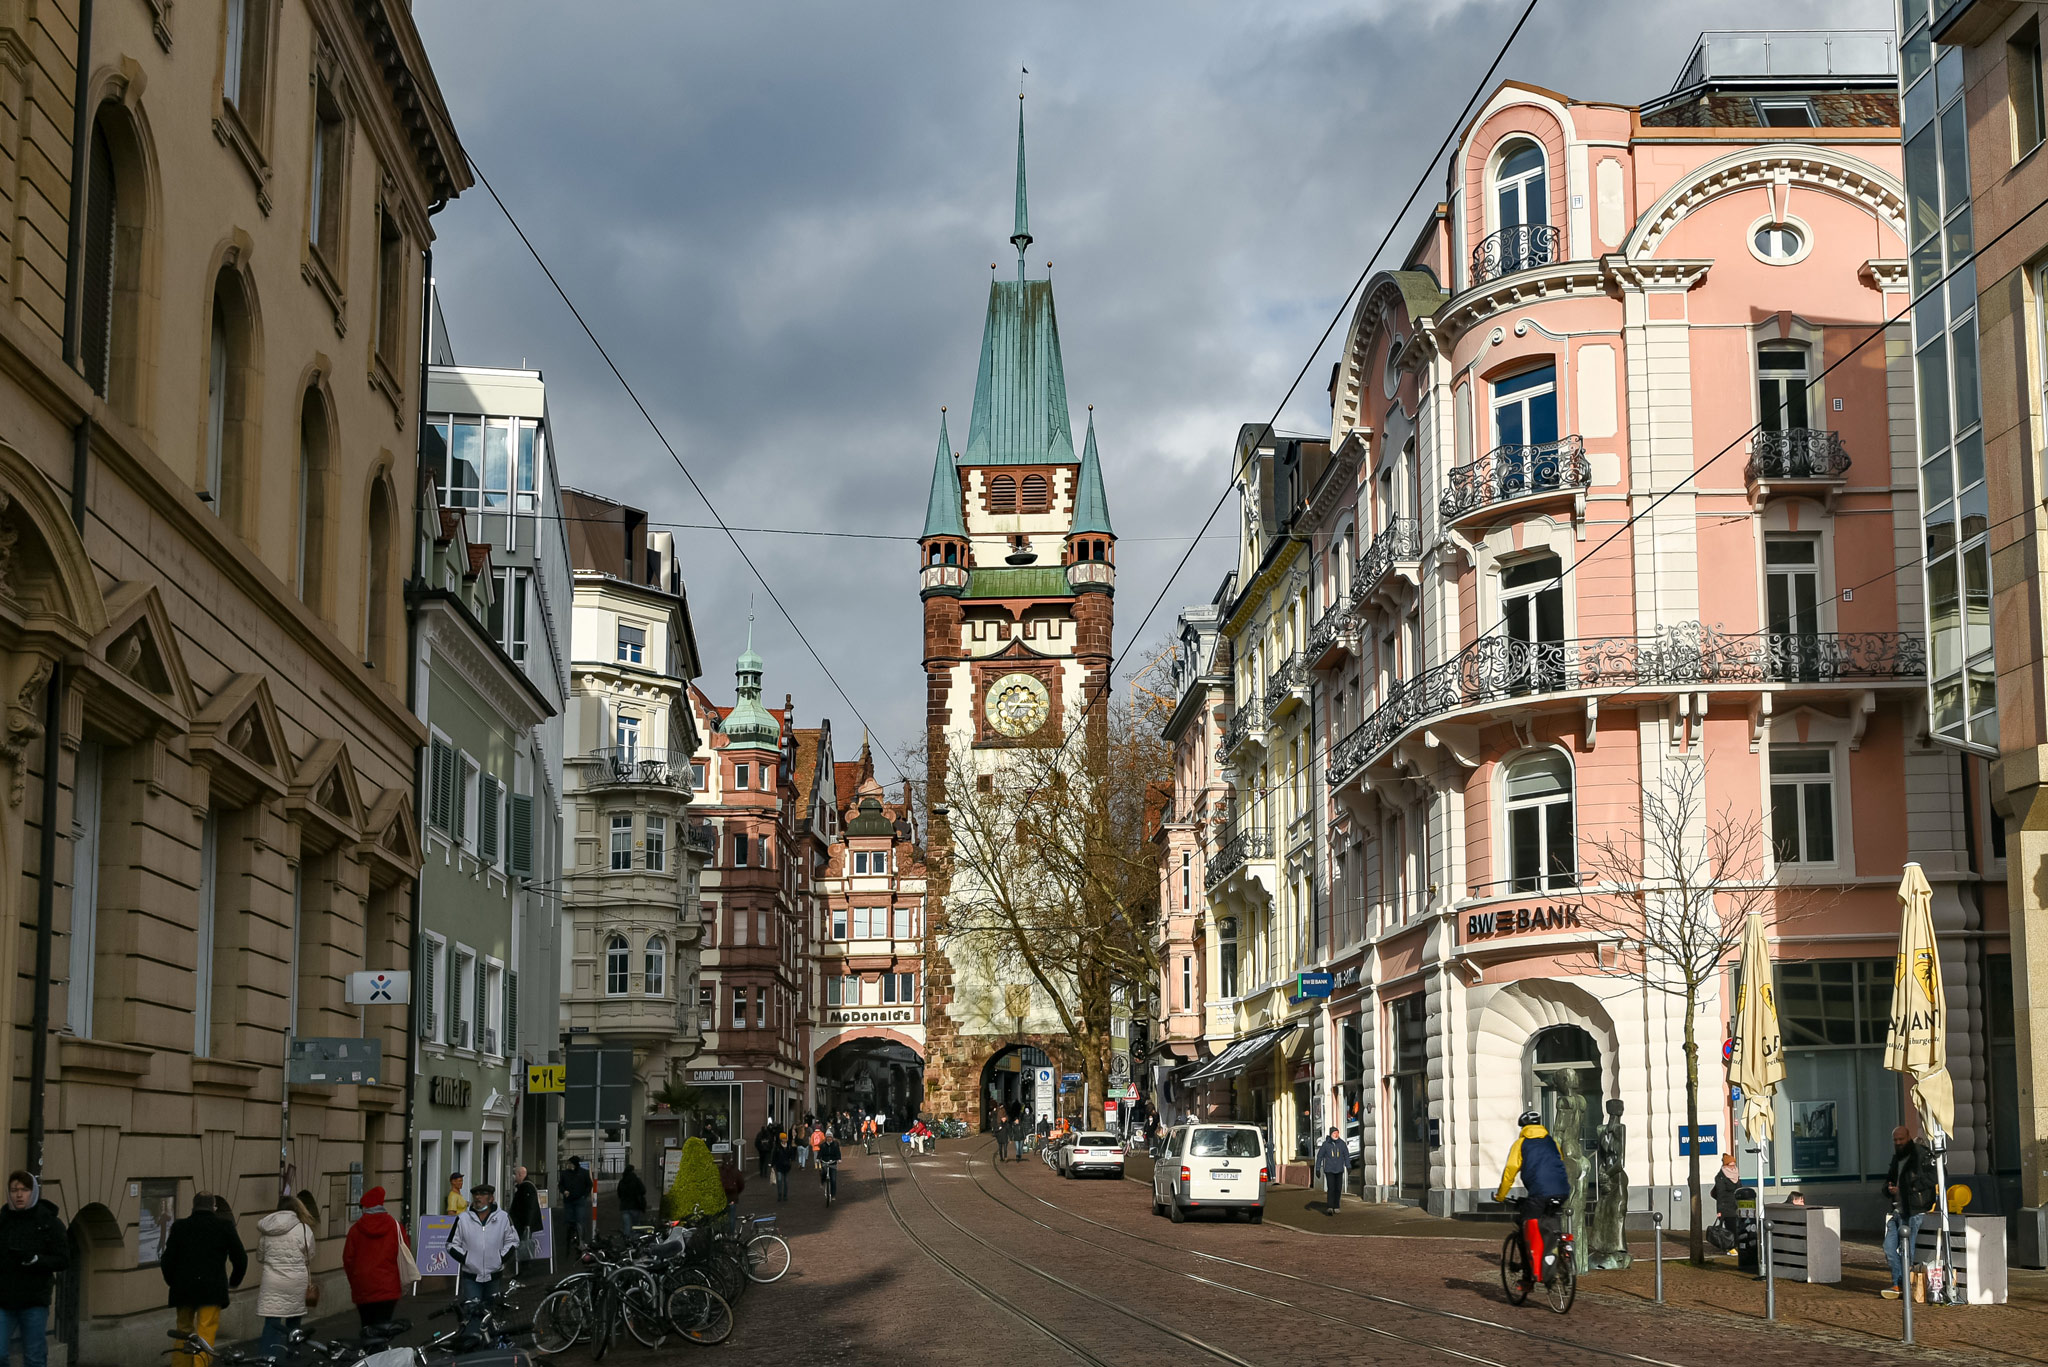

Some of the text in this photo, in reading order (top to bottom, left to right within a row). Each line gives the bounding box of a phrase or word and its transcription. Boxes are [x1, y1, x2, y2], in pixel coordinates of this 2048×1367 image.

[1517, 904, 1580, 930] BANK
[830, 1010, 911, 1022] McDonald's
[693, 1070, 735, 1081] CAMP DAVID
[432, 1075, 472, 1108] amara
